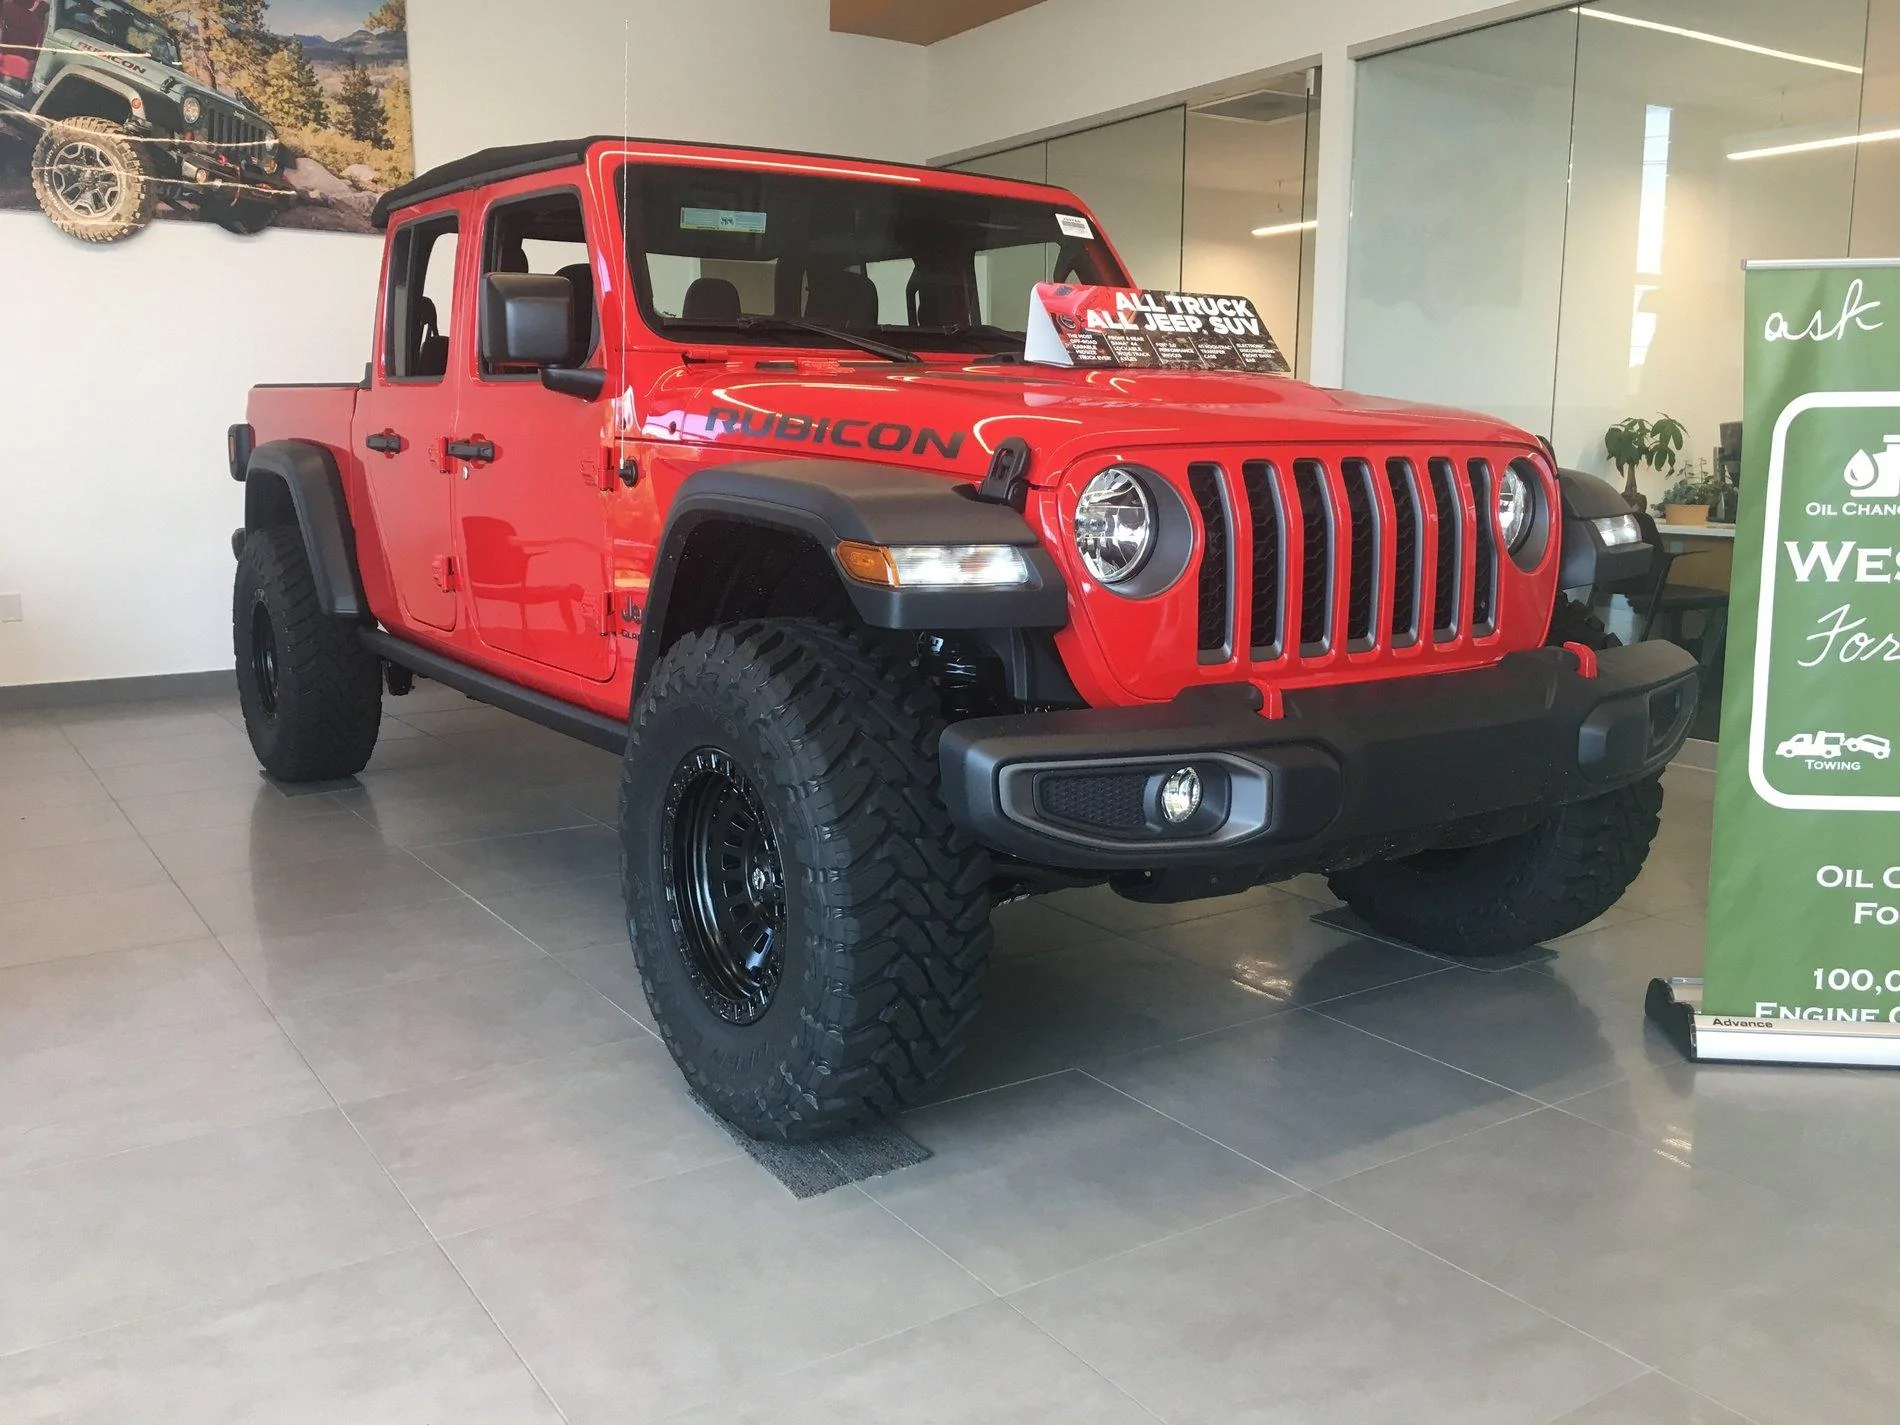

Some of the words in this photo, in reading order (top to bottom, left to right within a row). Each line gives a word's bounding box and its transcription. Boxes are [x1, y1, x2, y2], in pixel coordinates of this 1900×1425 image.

[1115, 291, 1166, 313] ALL
[1168, 295, 1256, 318] TRUCK
[1764, 278, 1883, 341] ask
[1086, 309, 1139, 331] ALL
[1213, 317, 1261, 336] SUV
[705, 406, 967, 459] RUBICON
[1805, 501, 1838, 516] OIL
[1842, 501, 1900, 516] CHAN
[1784, 541, 1900, 584] WE
[1805, 759, 1861, 771] TOWING
[1816, 865, 1874, 888] OIL
[1712, 1018, 1774, 1029] Advance
[1755, 1001, 1880, 1022] ENGINE
